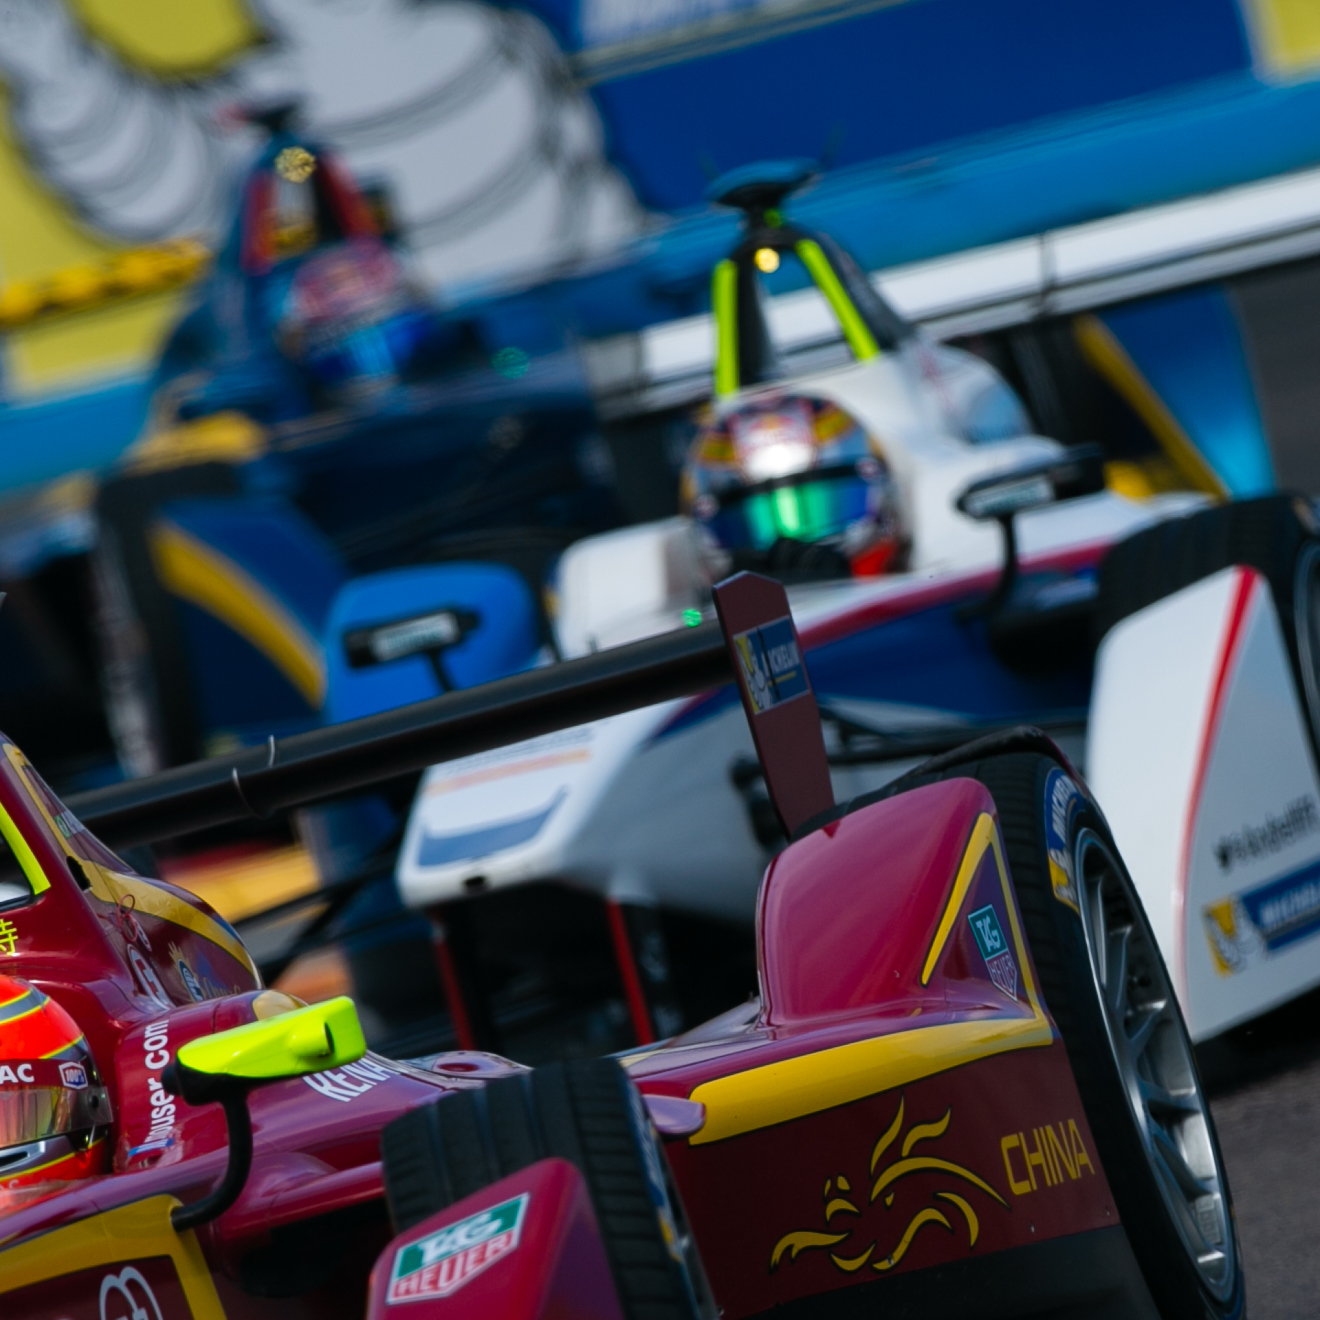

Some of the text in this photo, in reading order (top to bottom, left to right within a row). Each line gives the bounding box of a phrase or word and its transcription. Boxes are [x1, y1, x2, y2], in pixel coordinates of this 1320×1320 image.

[976, 914, 1001, 952] TAG
[989, 955, 1018, 994] HEUER
[1000, 1118, 1095, 1196] CHINA
[393, 1230, 513, 1299] HEUER
[418, 1212, 503, 1265] TAG
